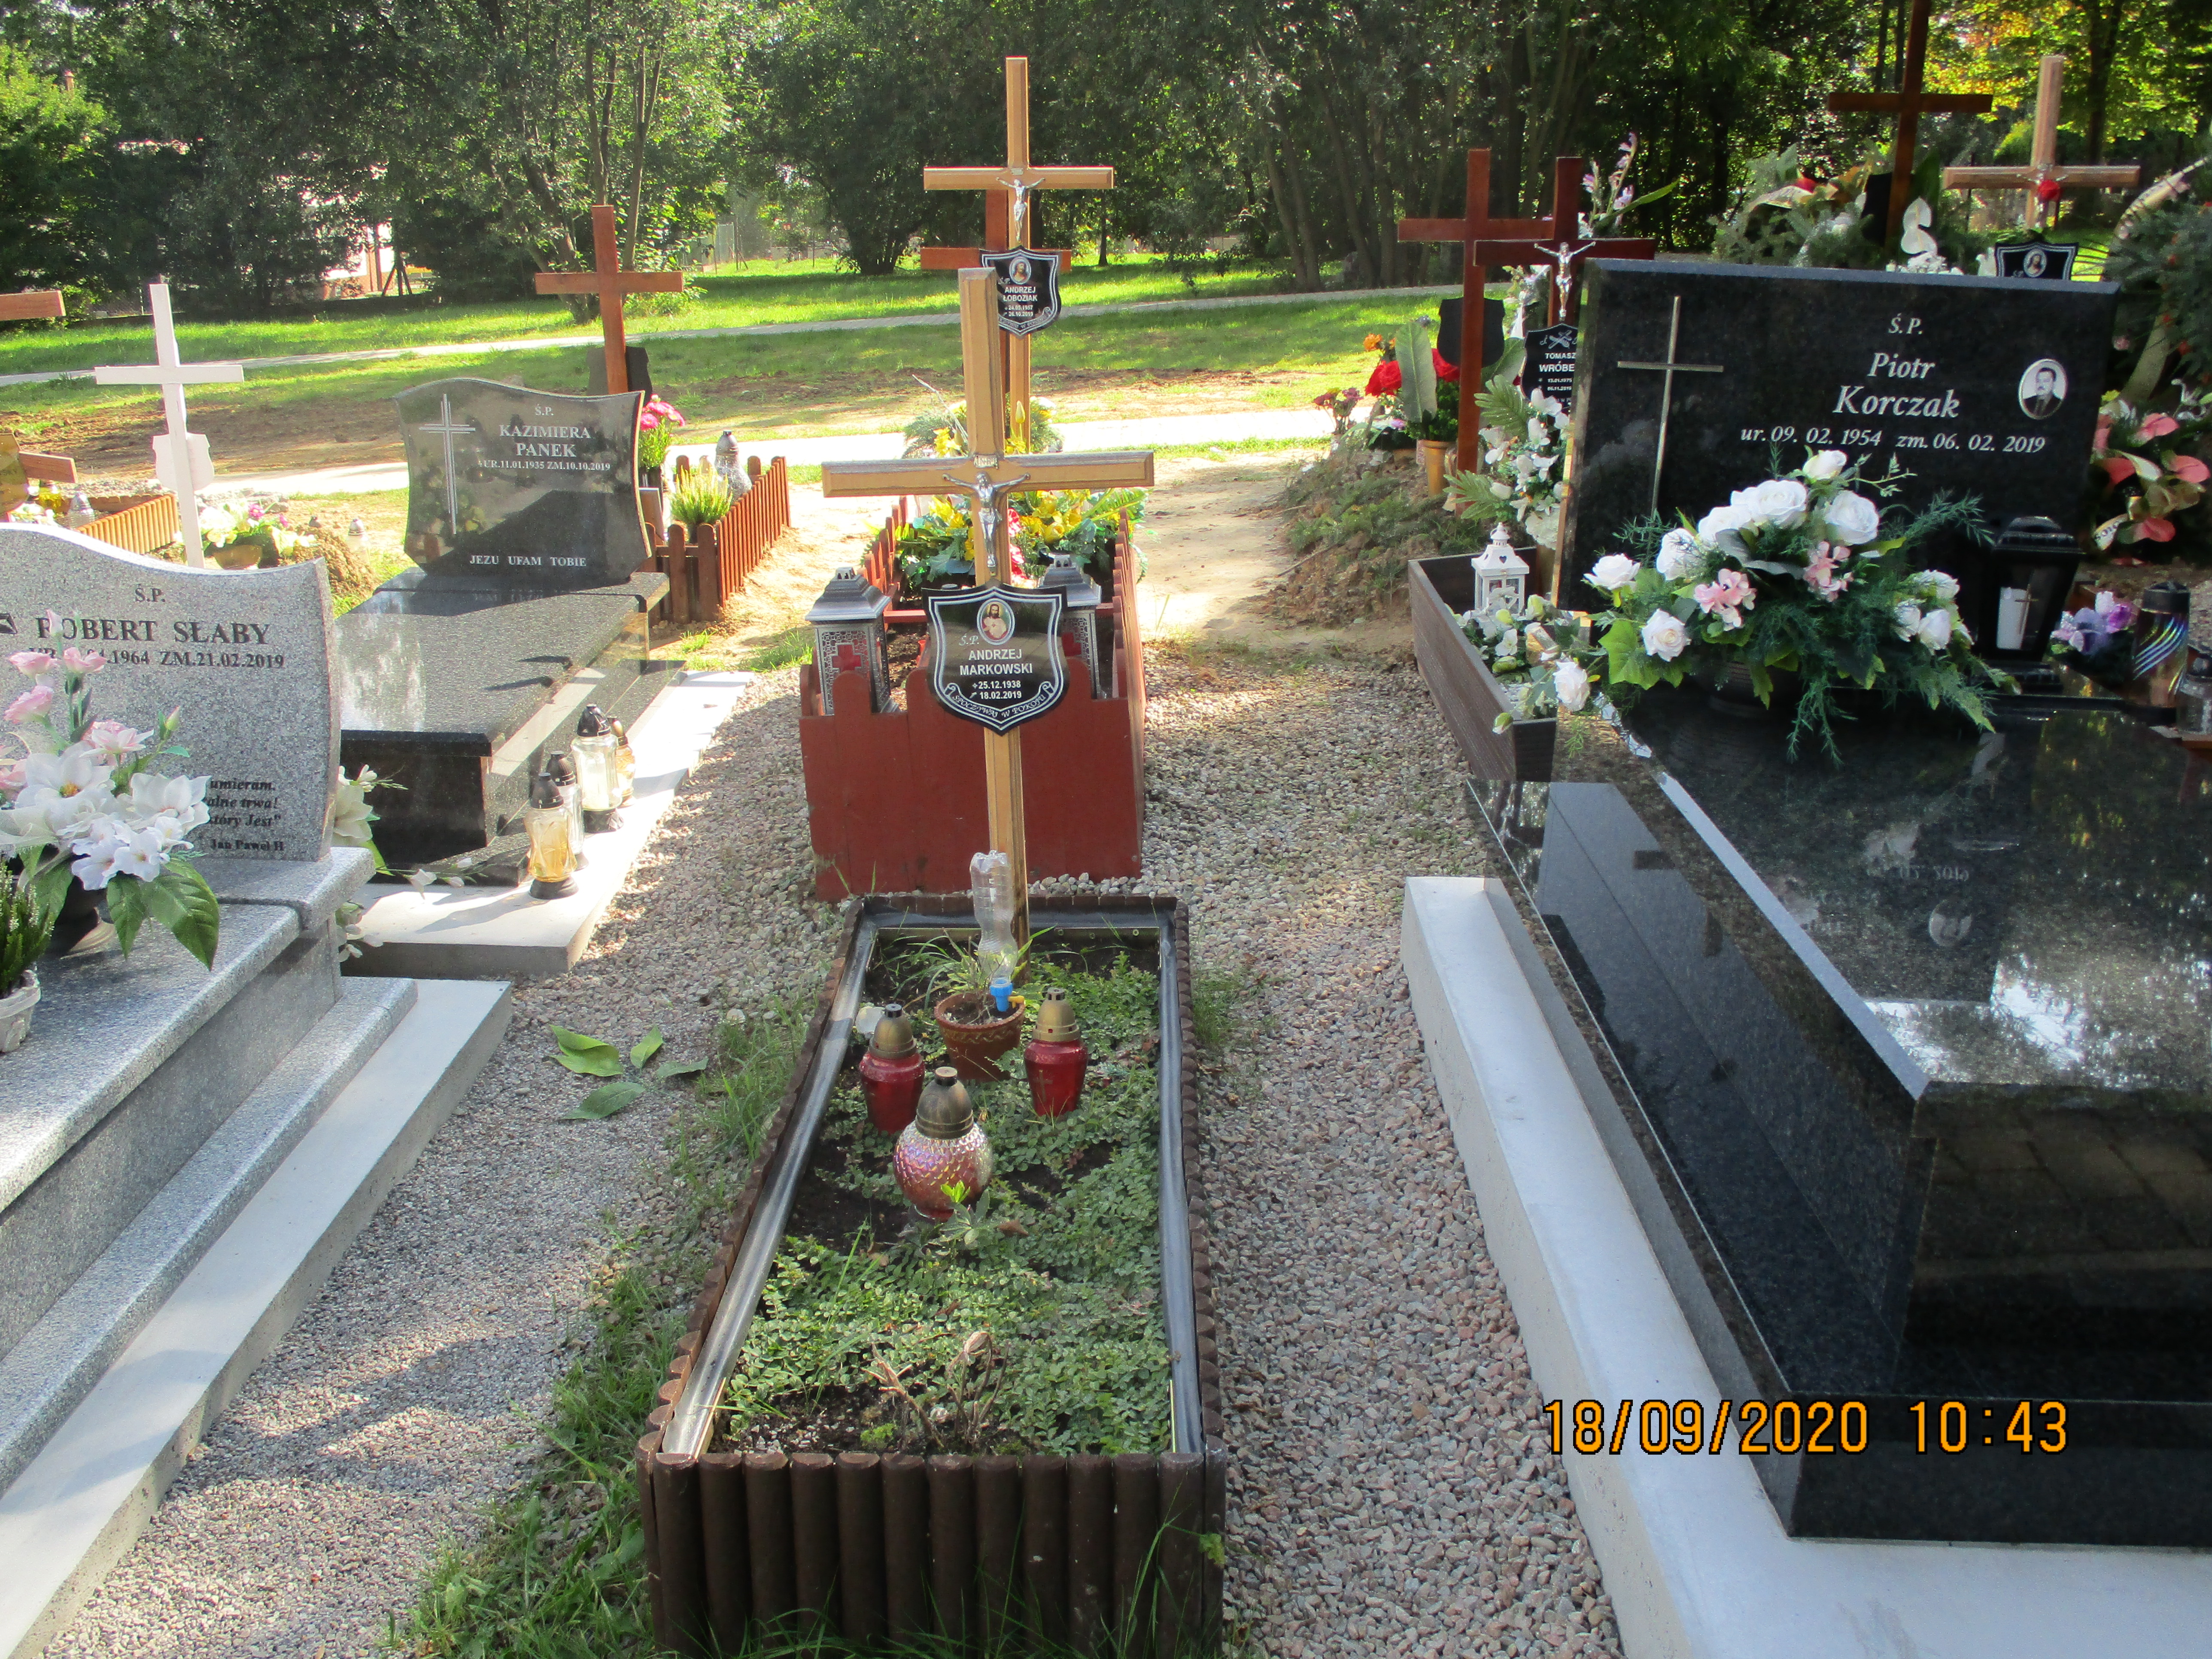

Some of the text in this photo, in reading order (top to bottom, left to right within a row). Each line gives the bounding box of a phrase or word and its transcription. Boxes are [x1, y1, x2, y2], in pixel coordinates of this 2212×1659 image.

[1867, 352, 1936, 380] Piotr
[1832, 385, 1960, 418] Korczak
[499, 425, 591, 439] KAZIMIERA
[1741, 426, 2046, 453] ur. 09. 02. 1954 zm. 06. 02. 2019
[516, 443, 576, 458] PANEK
[547, 461, 610, 471] ZM.10.10.2019
[470, 555, 587, 567] JEZU UFAM TOBIE
[173, 621, 270, 645] SŁABY
[159, 650, 285, 668] ZM.21.02.2019
[968, 649, 1022, 660] ANDRZEJ
[960, 663, 1033, 675] MARKOWSKI
[978, 681, 1021, 689] 25.12.1938
[979, 691, 1022, 699] 18.02.2019
[1001, 709, 1010, 717] W
[1012, 694, 1046, 714] POKOJU
